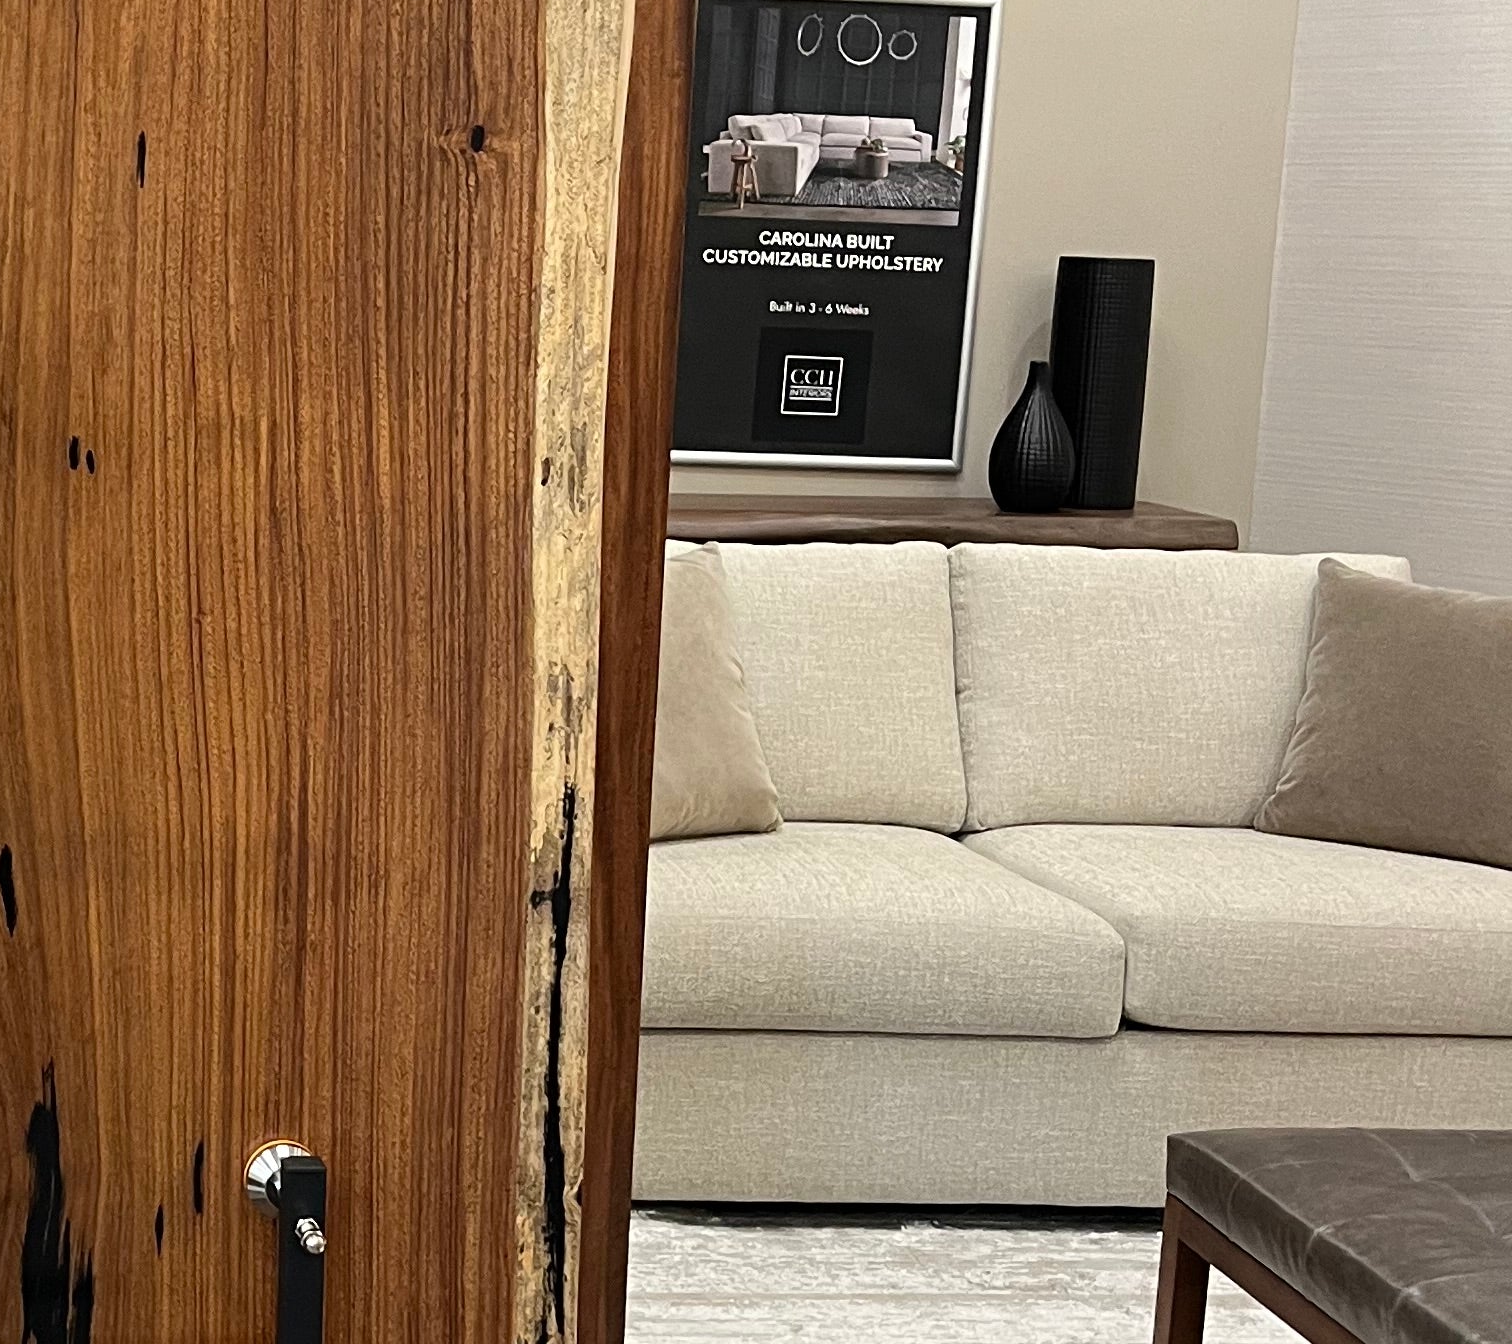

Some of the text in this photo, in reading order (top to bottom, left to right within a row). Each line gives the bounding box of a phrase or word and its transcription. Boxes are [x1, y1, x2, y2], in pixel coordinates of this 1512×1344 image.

[758, 230, 894, 250] CAROLINA BUILT
[702, 248, 944, 272] CUSTOMIZABLE UPHOLSTERY
[769, 300, 793, 312] Built
[795, 301, 806, 313] in
[808, 302, 816, 314] 3
[824, 303, 833, 314] 6
[835, 303, 870, 316] Weeks
[790, 368, 834, 386] CCH
